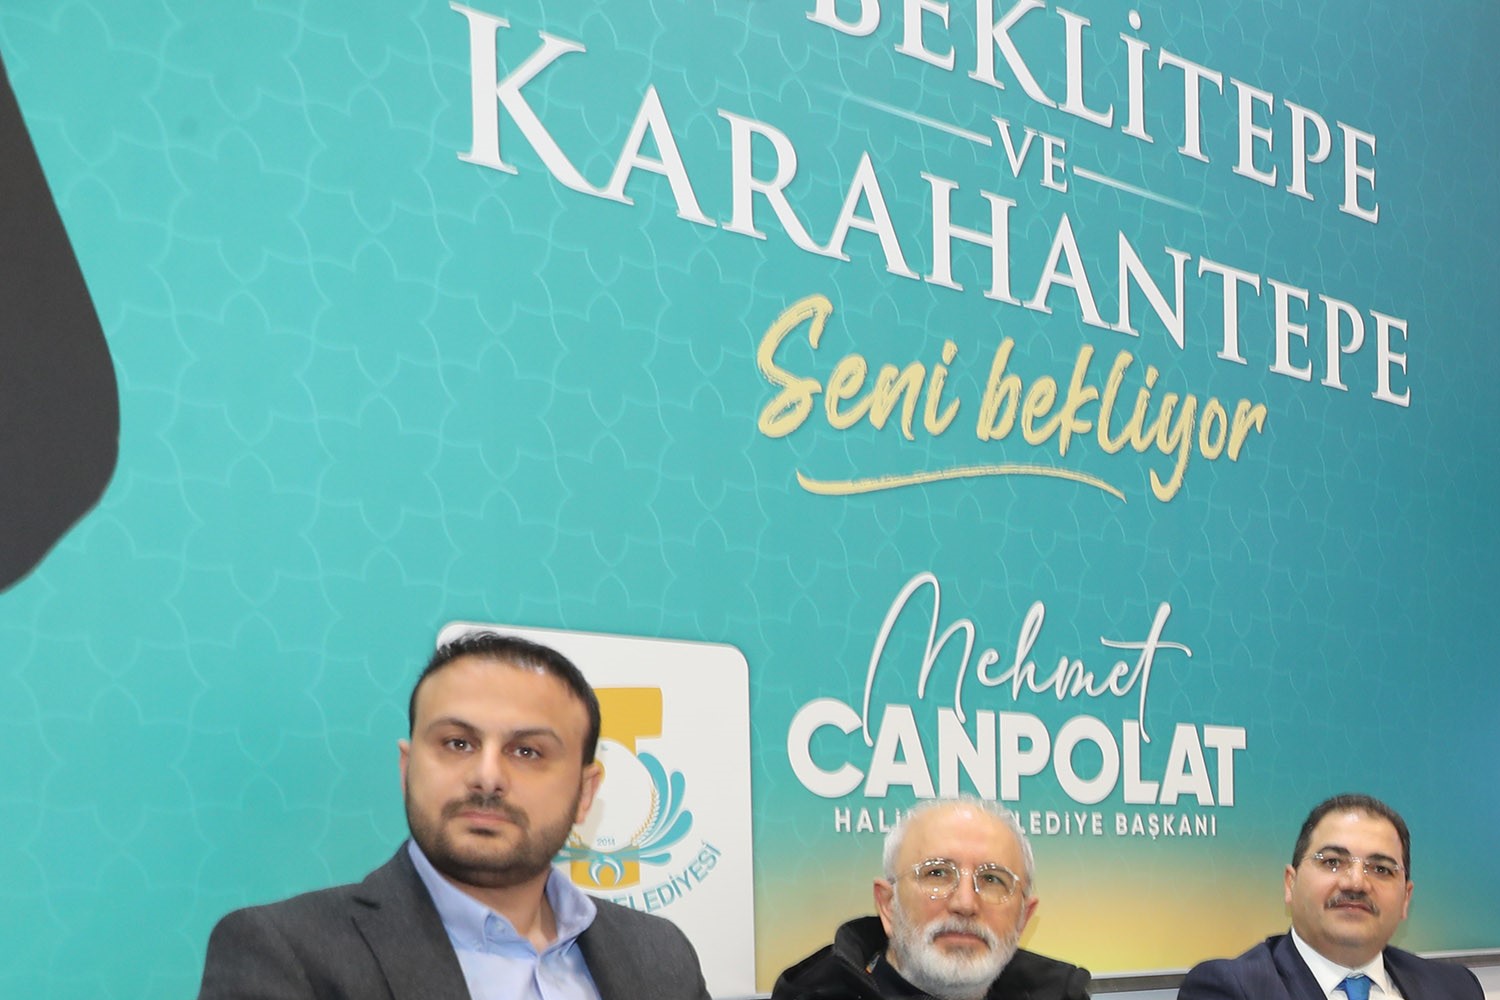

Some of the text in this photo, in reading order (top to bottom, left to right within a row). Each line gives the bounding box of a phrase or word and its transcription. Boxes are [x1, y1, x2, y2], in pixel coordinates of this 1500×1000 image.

[449, 1, 1411, 407] KARAHANTEPE
[991, 115, 1068, 193] VE
[757, 294, 1266, 502] Seni bekliyor
[862, 571, 1192, 747] Mehmet
[787, 698, 1247, 806] CANPOLAT
[1115, 812, 1217, 840] BAŞKANI
